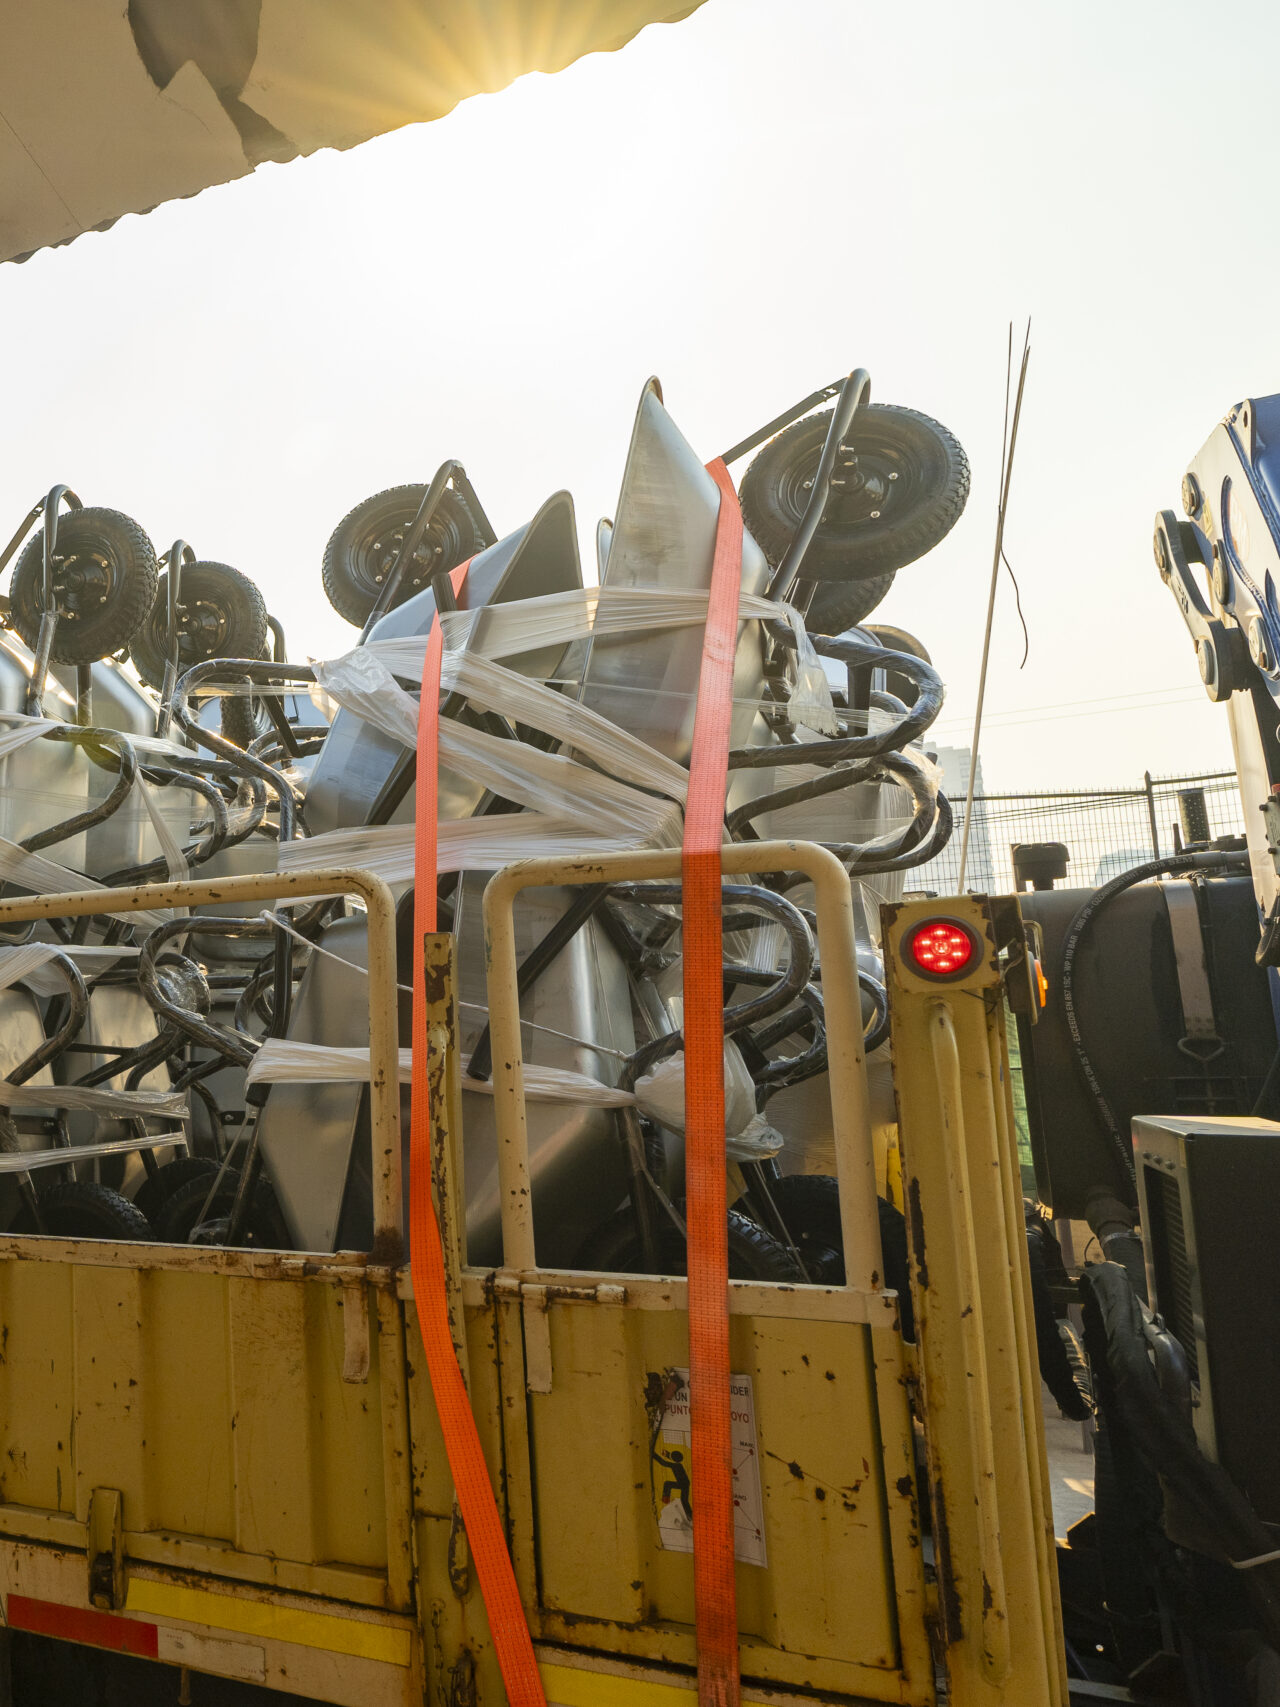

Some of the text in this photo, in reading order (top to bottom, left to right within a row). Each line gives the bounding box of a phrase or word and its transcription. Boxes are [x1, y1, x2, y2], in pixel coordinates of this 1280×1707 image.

[1067, 932, 1080, 949] BAR
[1062, 959, 1072, 972] WP
[1064, 1000, 1073, 1012] EN
[1066, 1011, 1082, 1042] EXCEEDS
[730, 1411, 750, 1423] OYO
